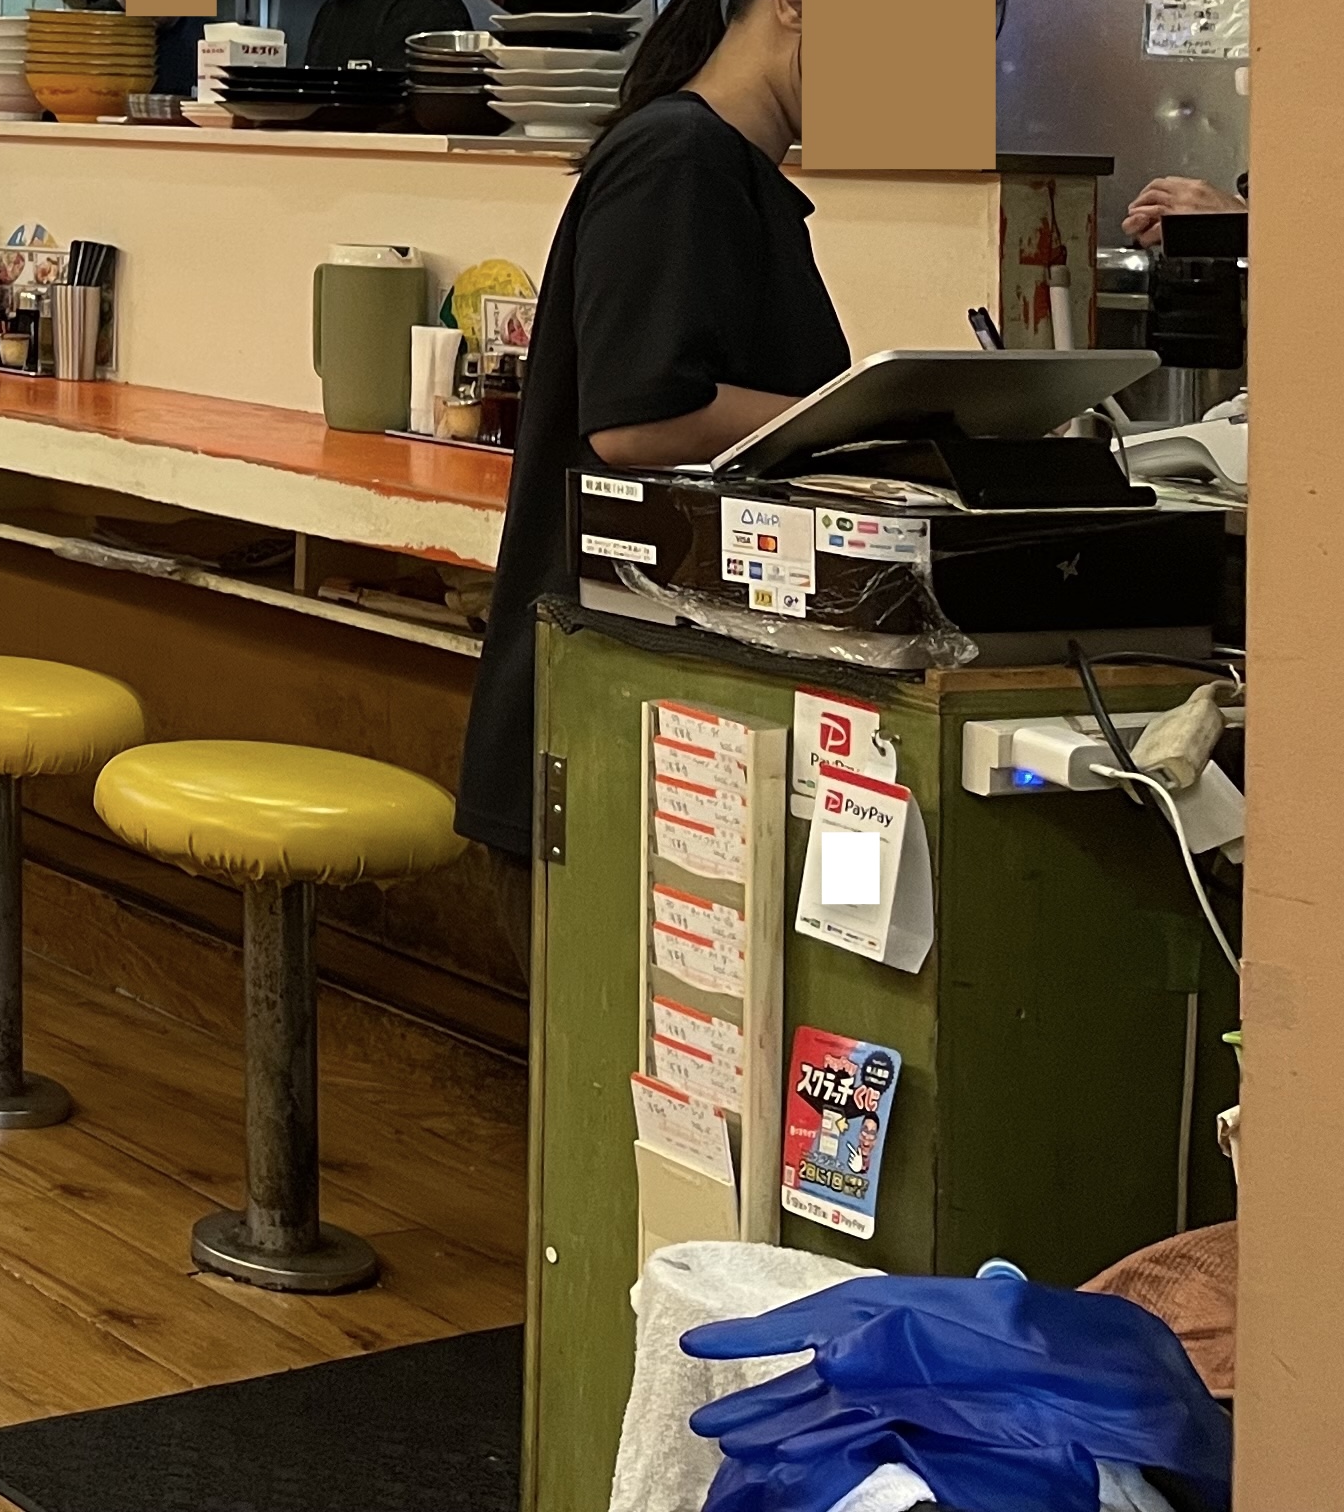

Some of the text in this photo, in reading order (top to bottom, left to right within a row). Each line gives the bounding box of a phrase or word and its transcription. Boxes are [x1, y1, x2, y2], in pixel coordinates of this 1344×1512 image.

[756, 512, 780, 526] AirP
[845, 798, 893, 828] PayPay
[797, 1063, 880, 1112] スクラッチくじ
